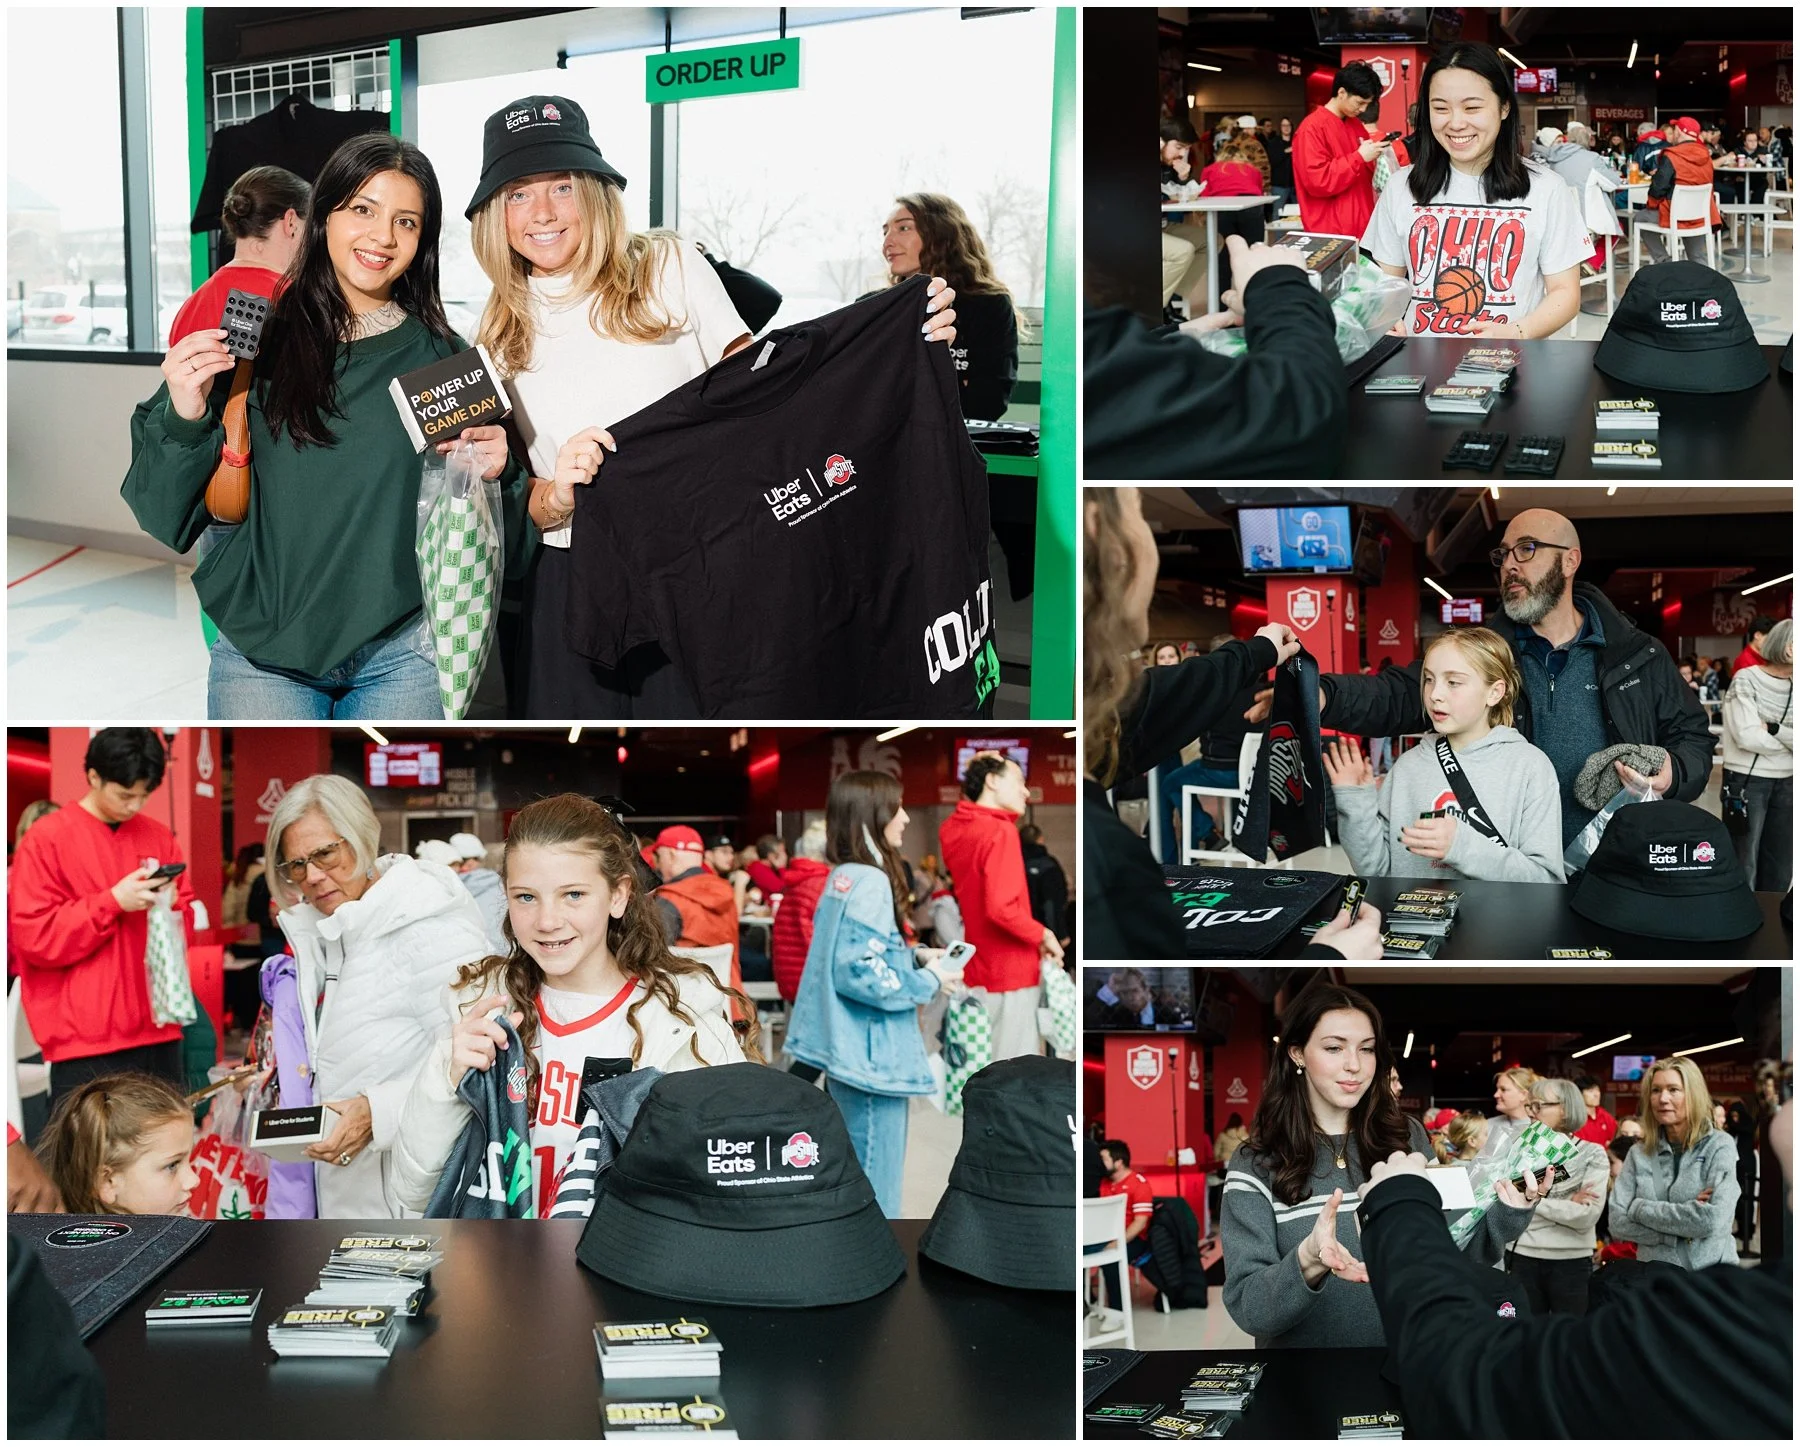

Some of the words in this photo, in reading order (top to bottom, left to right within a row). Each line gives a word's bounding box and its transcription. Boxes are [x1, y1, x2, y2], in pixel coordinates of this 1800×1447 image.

[656, 57, 743, 87] ORDER
[750, 52, 786, 77] UP
[505, 109, 528, 120] Uber
[1595, 107, 1645, 119] BEVERAGES
[506, 115, 530, 130] Eats
[1408, 214, 1526, 292] OHIO
[1660, 302, 1687, 312] Uber
[1413, 302, 1509, 336] State
[1660, 311, 1687, 321] Eats
[954, 359, 969, 370] ts
[410, 377, 466, 408] POWER
[463, 368, 484, 385] UP
[416, 396, 460, 421] YOUR
[424, 408, 469, 435] GAME
[468, 395, 497, 417] DAY
[1594, 442, 1633, 454] FREE
[763, 478, 801, 505] Uber
[771, 493, 812, 521] Eats
[788, 517, 802, 527] Proud
[800, 508, 818, 520] Sponsor
[828, 494, 840, 503] State
[839, 485, 857, 497] Athletics
[924, 578, 996, 685] COLU
[1437, 741, 1459, 775] NIKE
[1649, 844, 1678, 854] Uber
[1648, 853, 1678, 864] Eats
[1397, 893, 1430, 902] FREE
[1393, 904, 1428, 914] FREE
[1389, 938, 1425, 949] FREE
[707, 1139, 755, 1155] Uber
[707, 1156, 756, 1174] Eats
[735, 1179, 756, 1187] Sponsor
[341, 1238, 395, 1247] FREE
[159, 1299, 187, 1307] $7
[190, 1298, 247, 1306] SAVE
[283, 1311, 349, 1323] FREE
[605, 1327, 672, 1339] FREE
[1196, 1367, 1229, 1376] FREE
[1189, 1380, 1225, 1389] FREE
[606, 1406, 681, 1421] FREE
[1154, 1416, 1187, 1430] FREE
[1342, 1415, 1378, 1425] FREE
